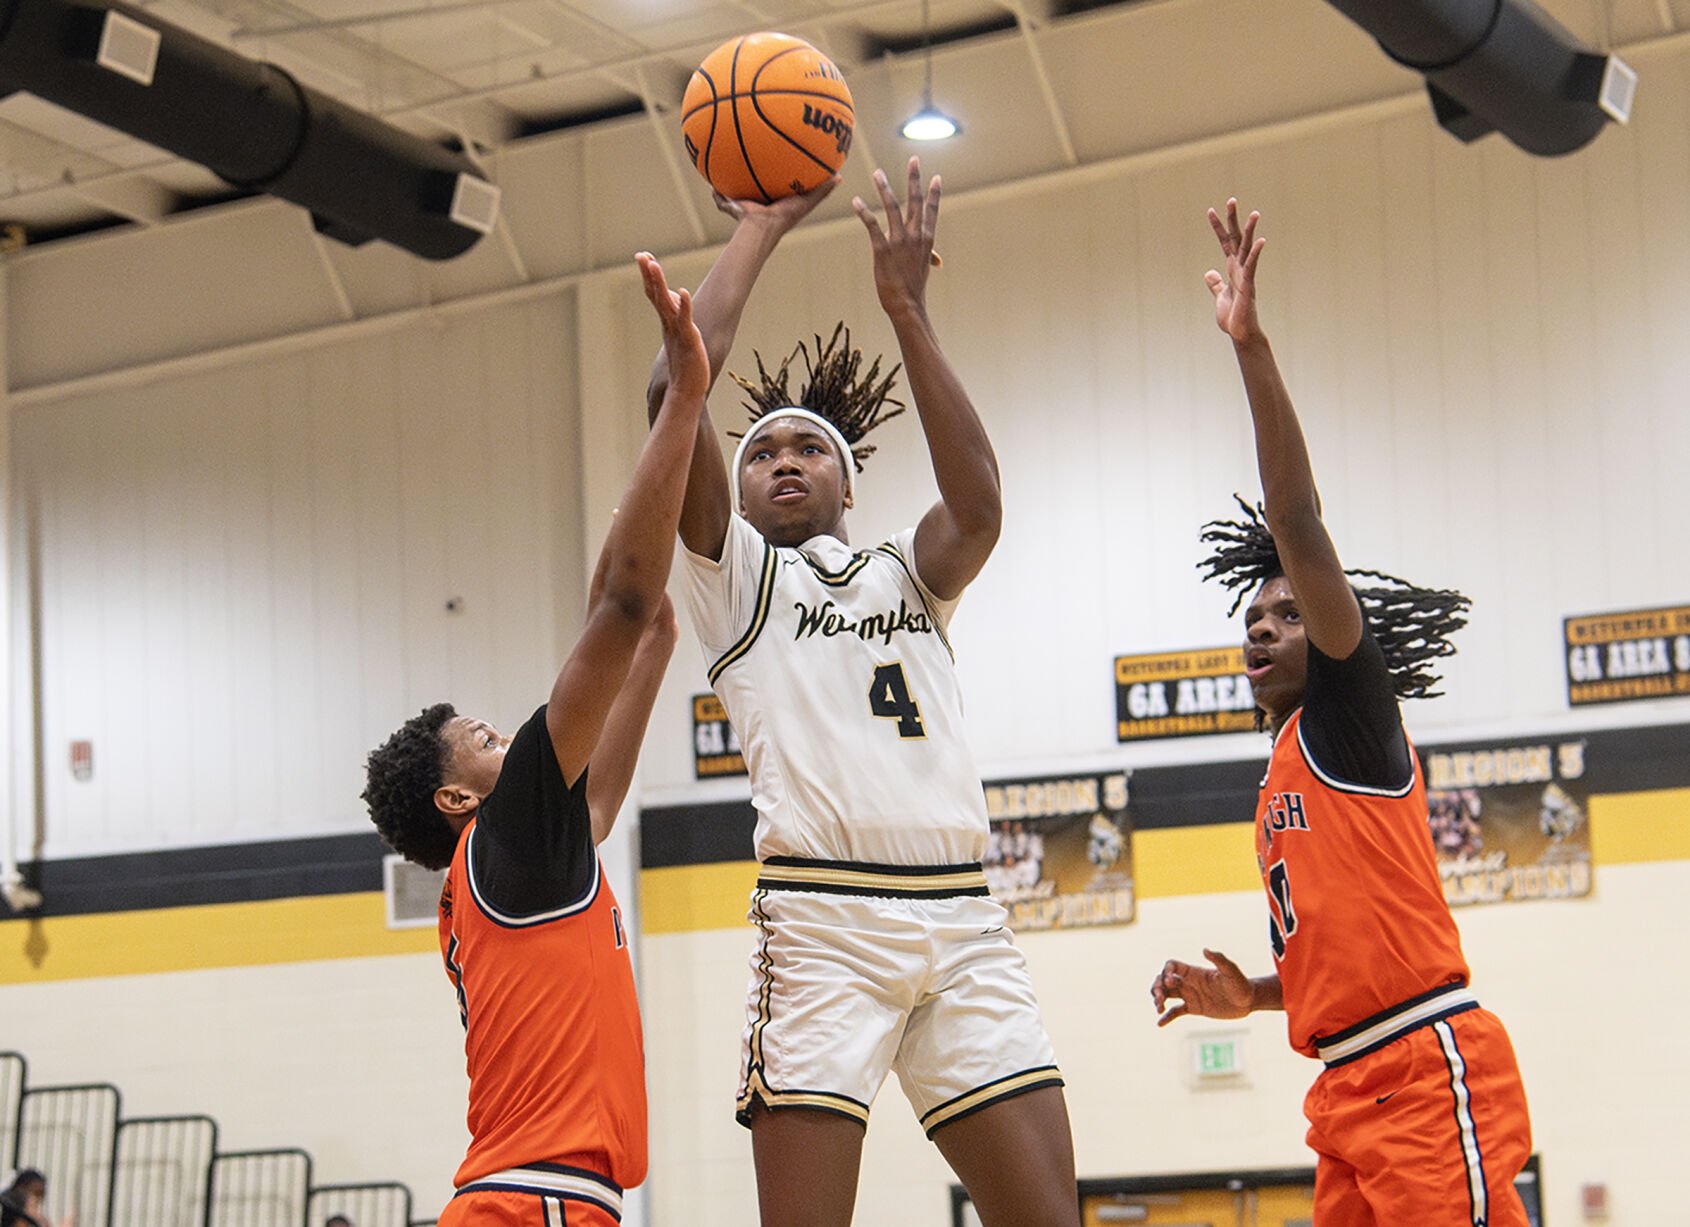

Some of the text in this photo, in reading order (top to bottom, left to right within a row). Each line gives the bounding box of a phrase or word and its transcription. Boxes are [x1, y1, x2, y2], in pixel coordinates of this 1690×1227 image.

[1606, 637, 1671, 680] AREA
[868, 659, 928, 740] 4
[1127, 673, 1255, 720] 6A AREA
[1428, 745, 1552, 790] REGION
